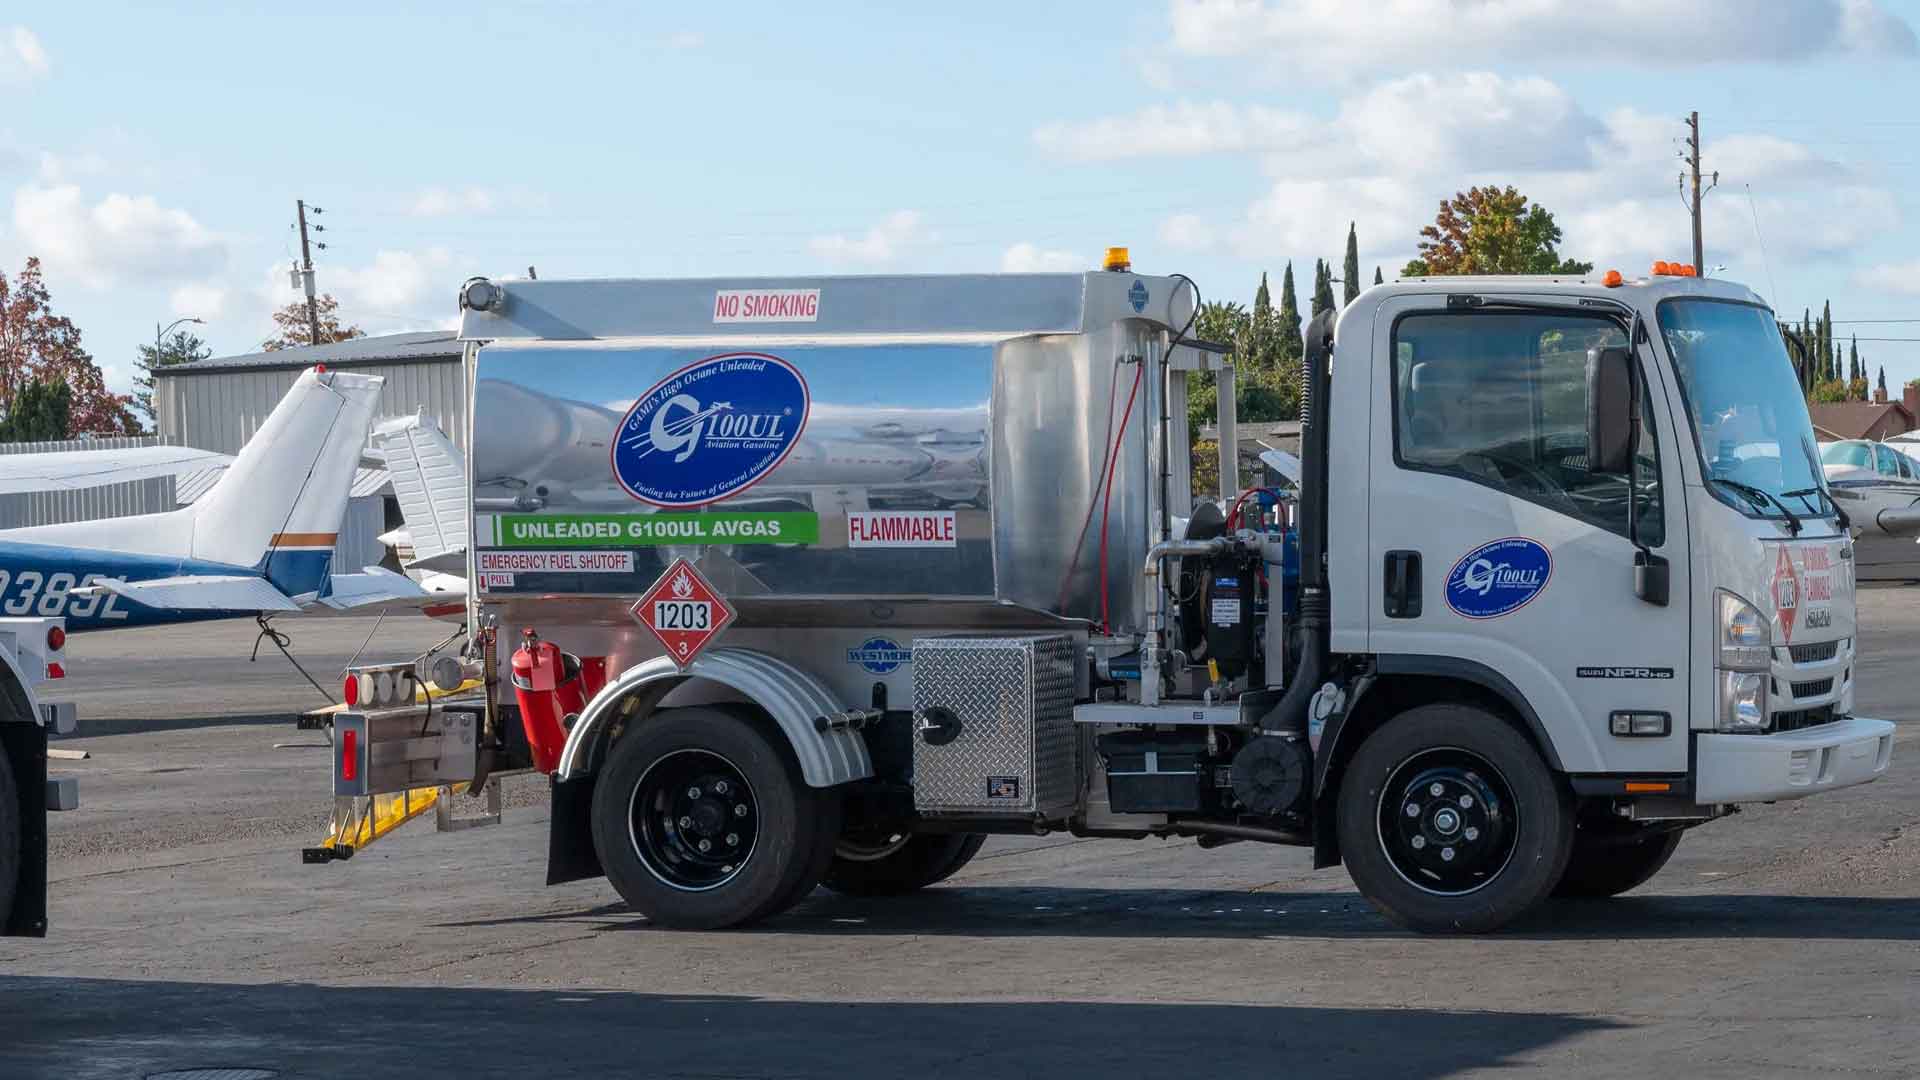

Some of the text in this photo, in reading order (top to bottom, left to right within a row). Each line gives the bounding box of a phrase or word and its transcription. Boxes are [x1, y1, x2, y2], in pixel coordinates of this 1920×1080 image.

[716, 294, 817, 317] NO SMOKING
[659, 381, 683, 400] High
[684, 368, 718, 385] Octane
[719, 360, 767, 373] Unleaded
[704, 440, 780, 450] Aviation Gasoline
[634, 451, 776, 499] Fueling the Future of General Aviation
[513, 520, 781, 538] UNLEADED G100UL AVGAS
[850, 517, 955, 541] FLAMMABLE
[481, 554, 628, 569] EMERGENCY FUEL SHUTOFF
[657, 603, 708, 629] 1203
[679, 641, 688, 655] 3
[1604, 668, 1650, 678] NPR
